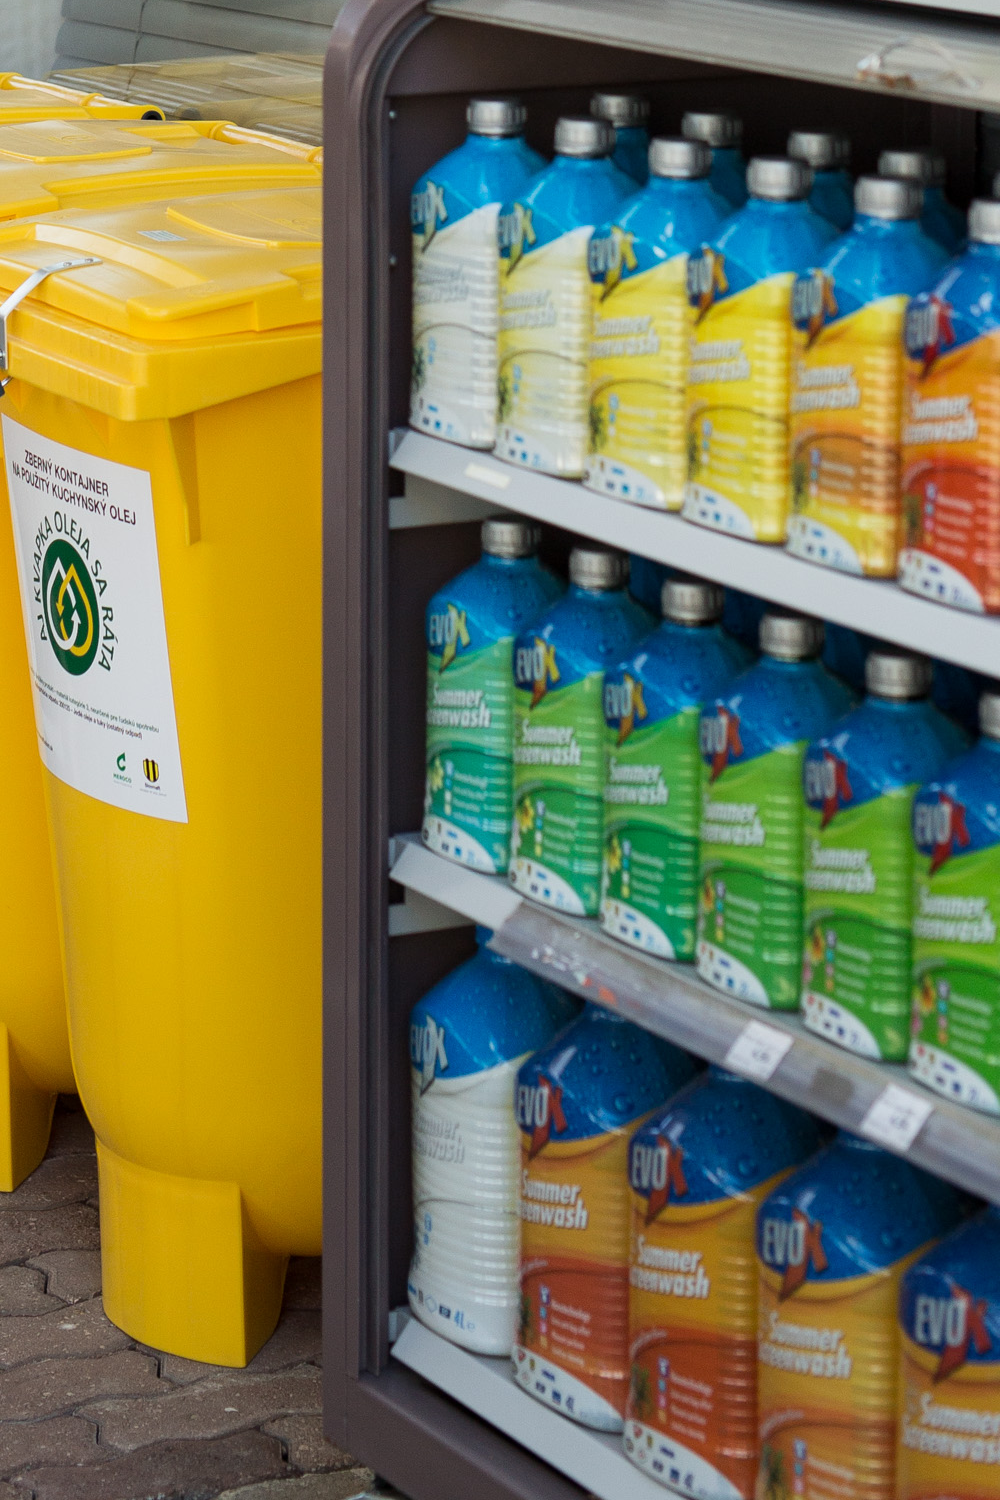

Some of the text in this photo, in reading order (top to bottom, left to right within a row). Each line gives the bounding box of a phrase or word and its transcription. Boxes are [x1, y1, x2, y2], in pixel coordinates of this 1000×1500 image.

[12, 461, 136, 525] NA POUŽITÝ KUCHYNSKÝ OLEJ
[24, 450, 109, 497] ZBERNÝ KONTAJNER
[33, 516, 53, 603] KVAPKA
[54, 511, 90, 559] OLEJA
[91, 560, 107, 598] SA
[98, 606, 118, 672] RÁTA
[430, 604, 470, 674] EVOX
[516, 636, 560, 710] EVOX
[136, 722, 160, 733] spotrebu
[113, 773, 132, 784] MEROCO
[518, 1074, 568, 1161] EVOX
[522, 1168, 582, 1205] Summer
[632, 1134, 688, 1227] EVOX
[638, 1234, 703, 1273] Summer
[763, 1207, 828, 1303] EVOX
[915, 1285, 991, 1385] EVOX
